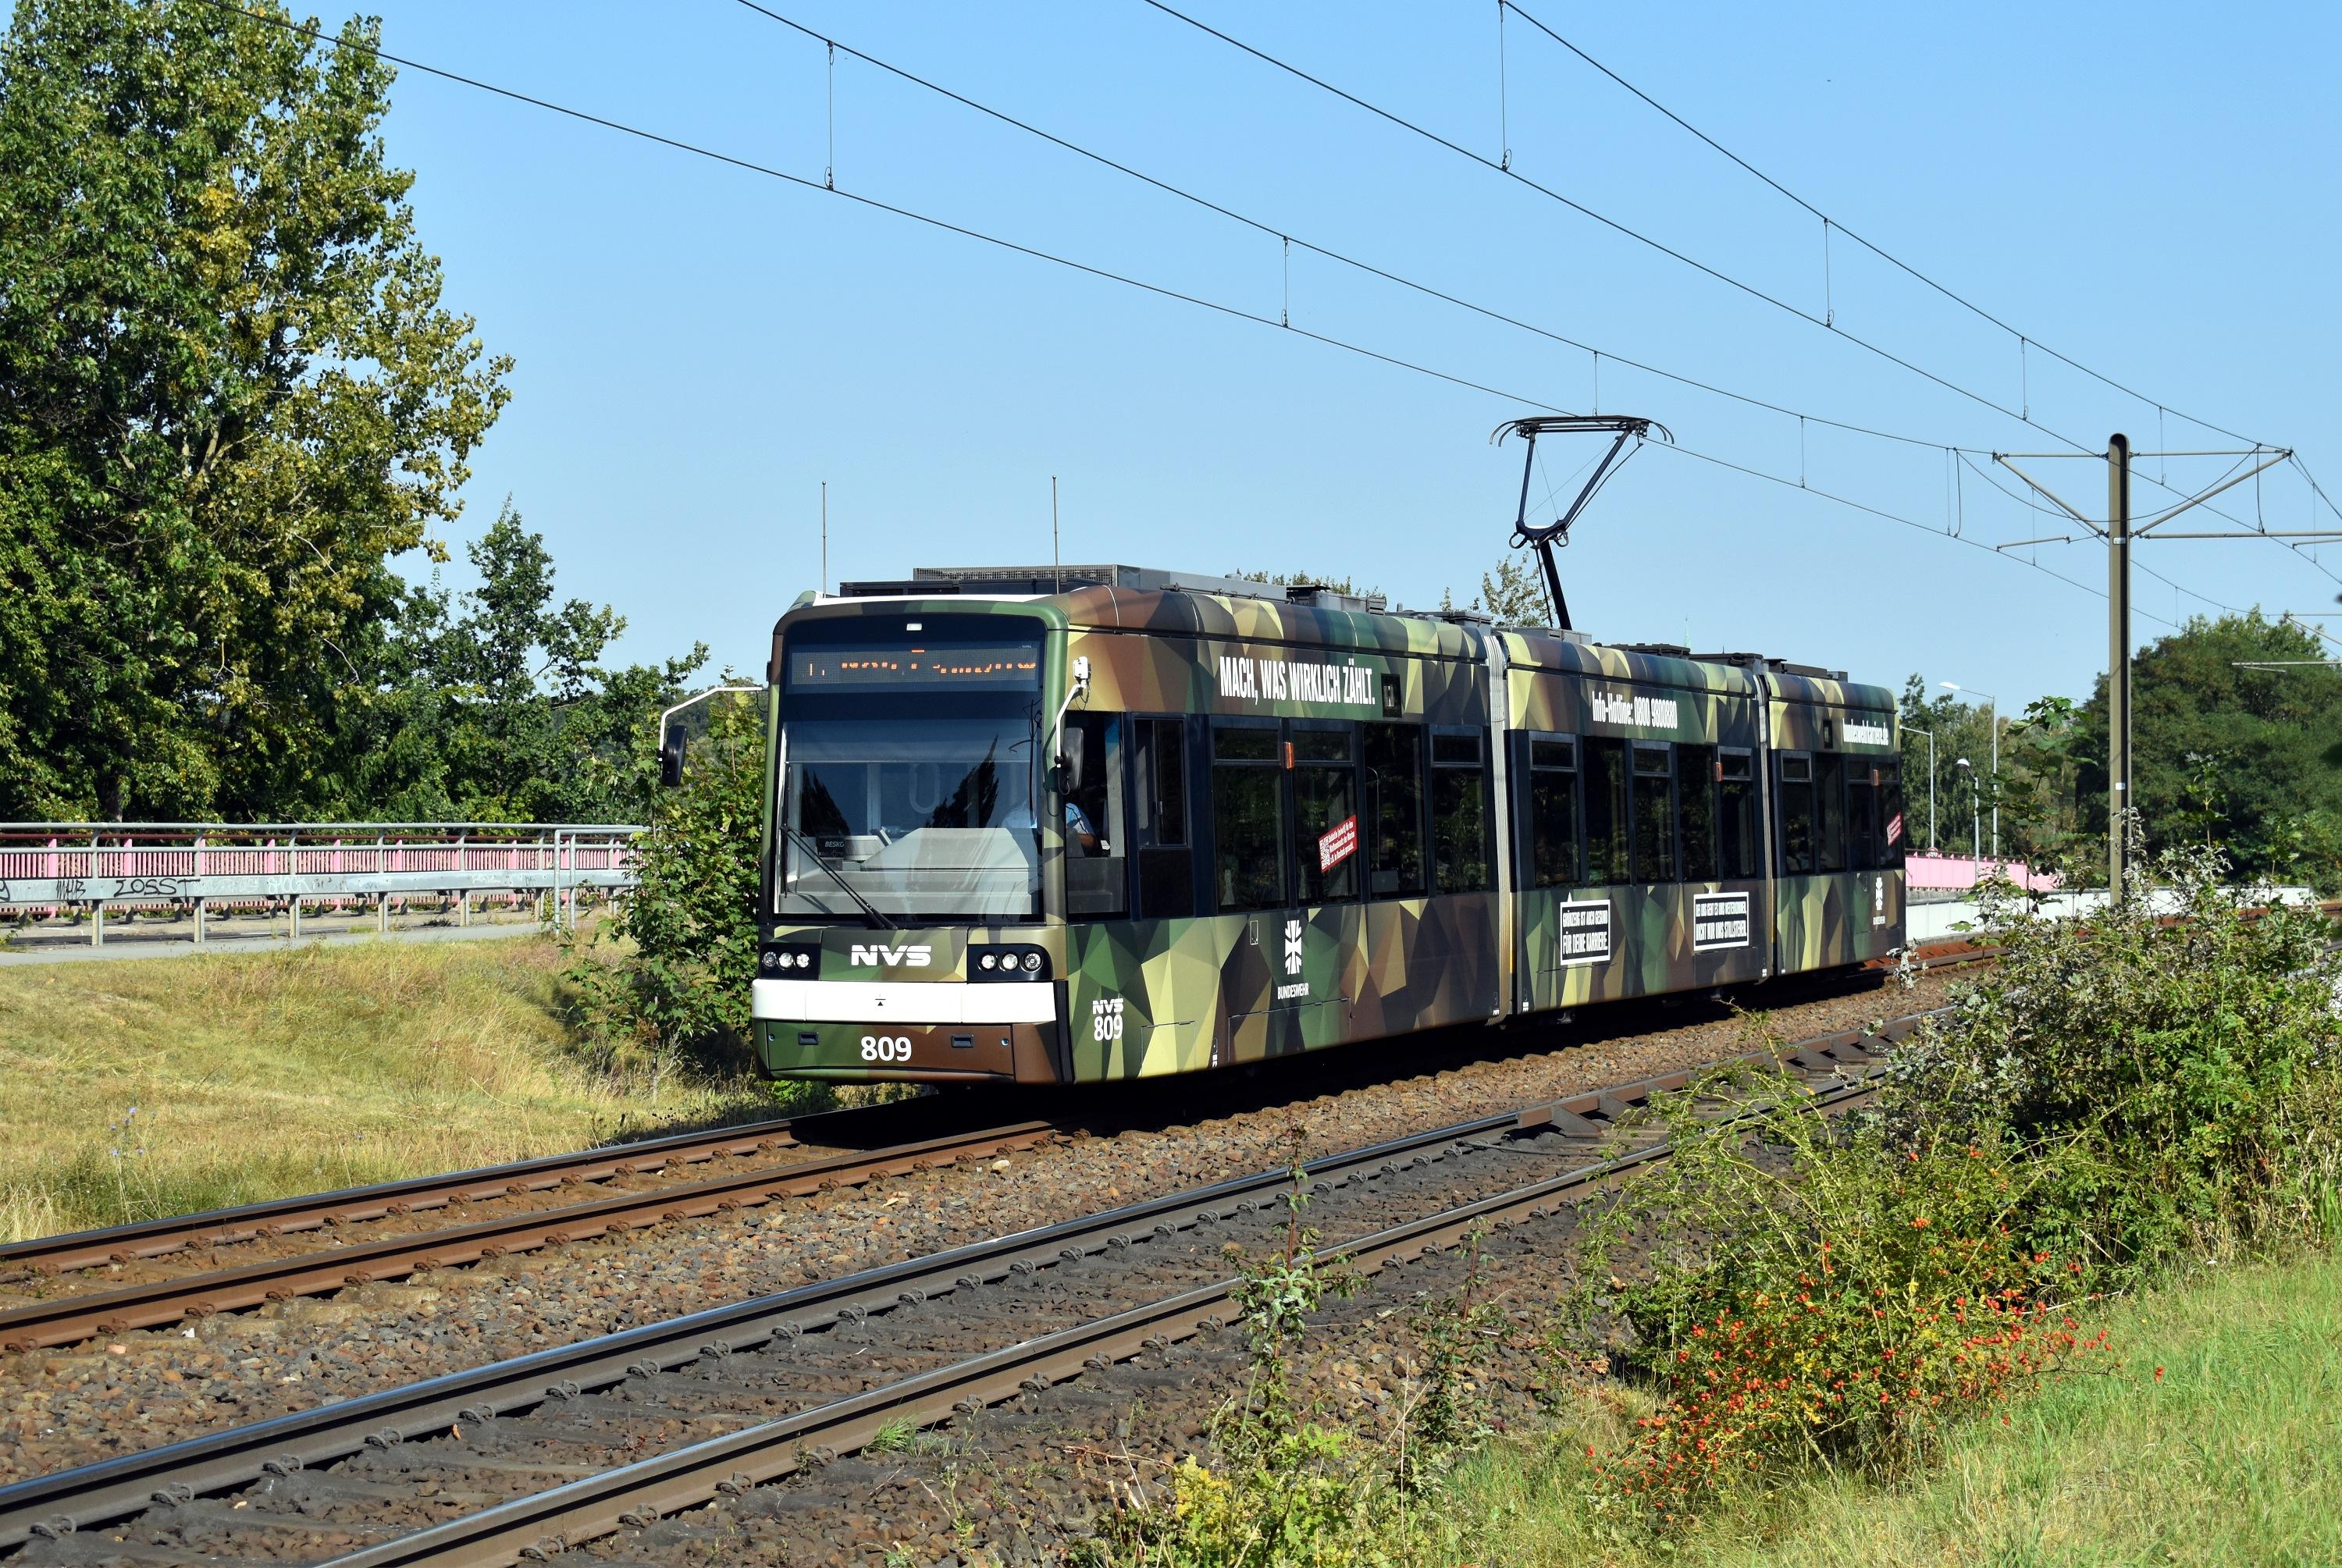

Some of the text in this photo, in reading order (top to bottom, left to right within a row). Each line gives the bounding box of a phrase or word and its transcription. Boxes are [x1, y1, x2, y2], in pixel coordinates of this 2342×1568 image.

[1219, 656, 1376, 705] MACH, WAS WIRKLICH ZÄHLT.
[1592, 691, 1678, 729] Info-Hotline: 0800 9800880
[851, 944, 932, 966] NVS
[1563, 930, 1572, 955] FÜR
[1572, 933, 1586, 953] DEINE
[1277, 983, 1309, 1000] BUNDESWEHR
[1092, 997, 1124, 1015] NVS
[1094, 1015, 1123, 1041] 809
[860, 1036, 912, 1061] 809
